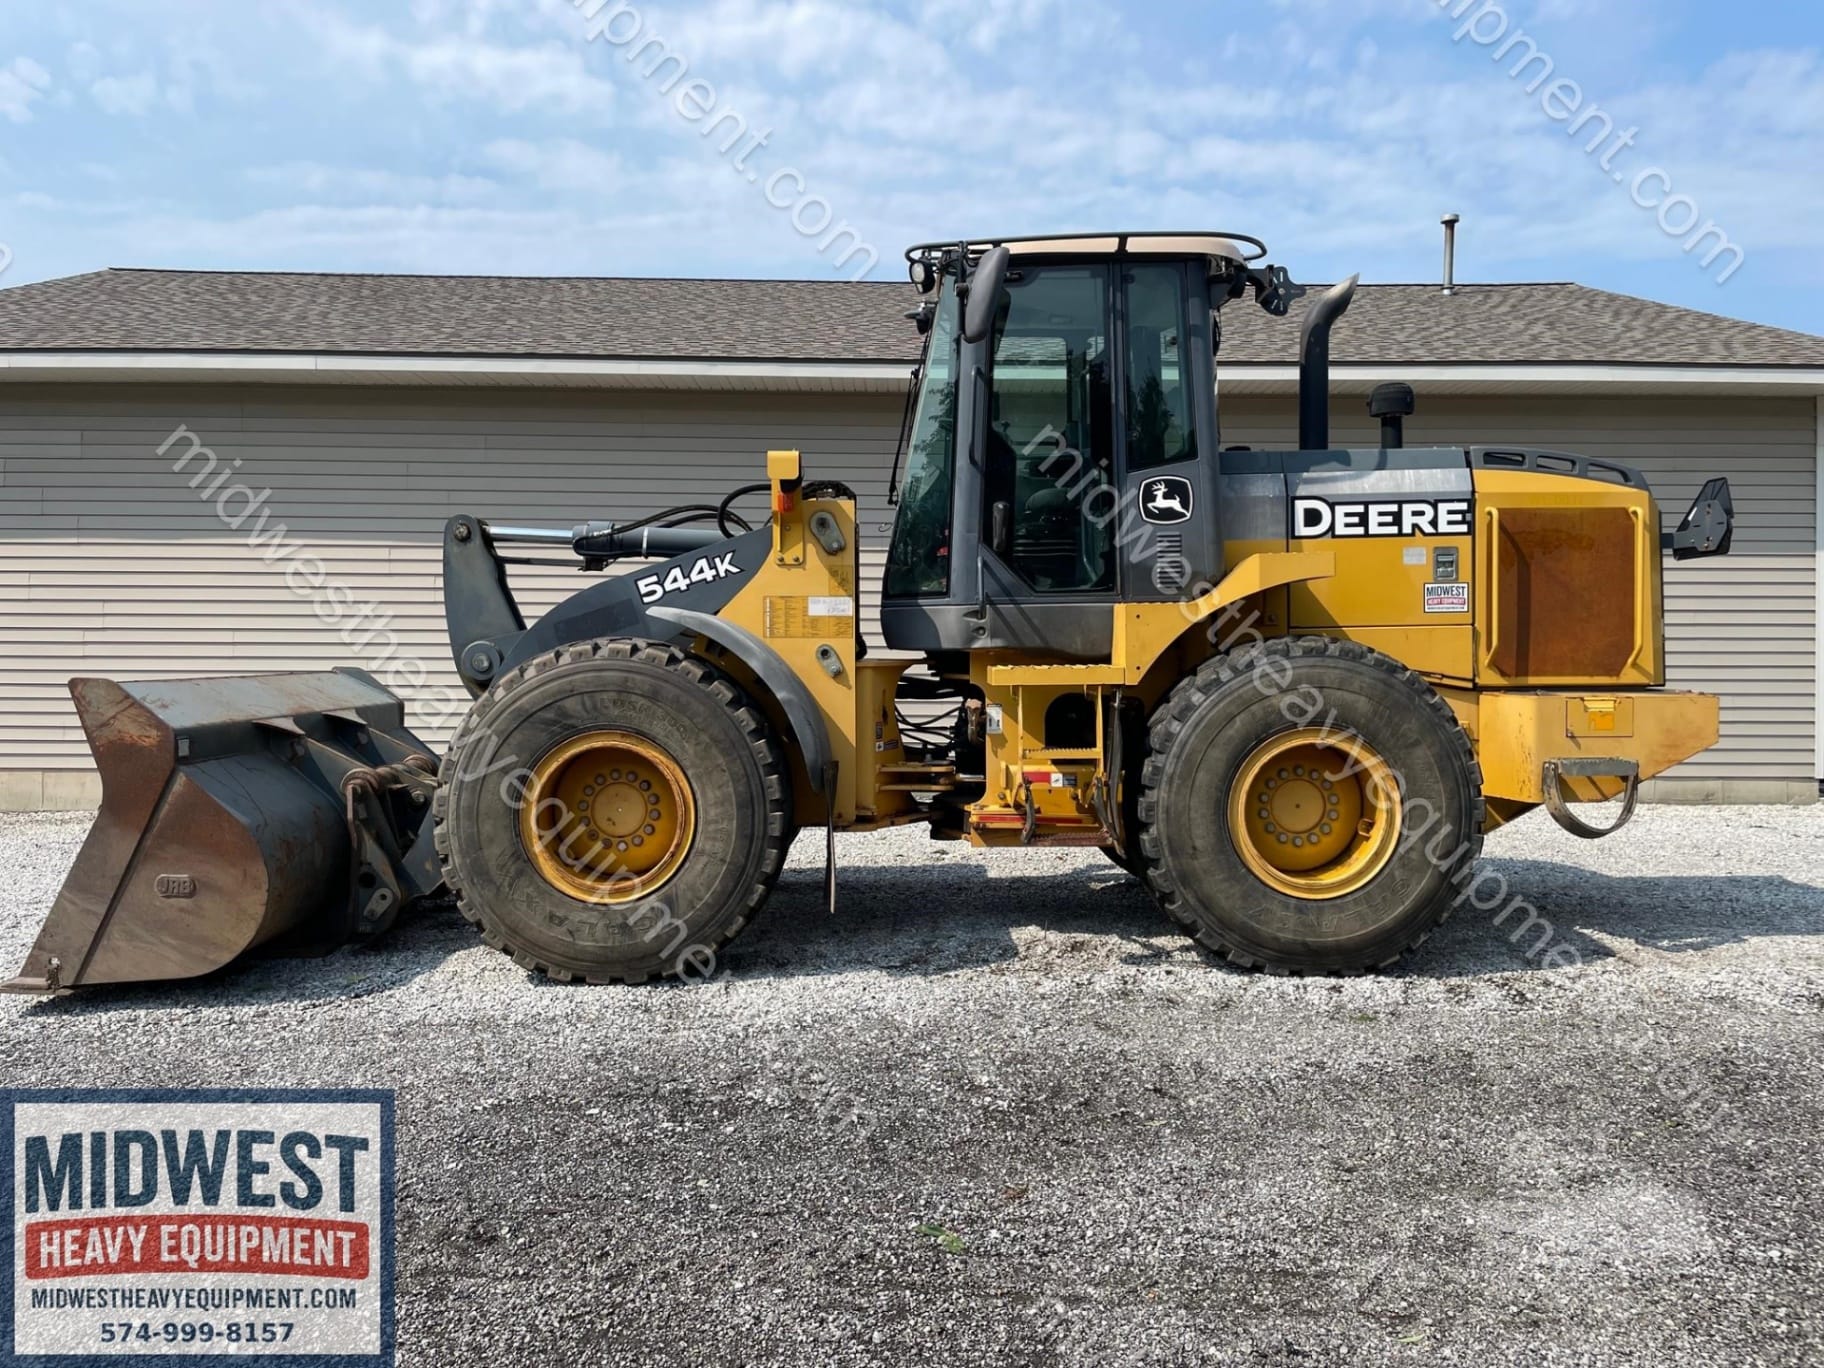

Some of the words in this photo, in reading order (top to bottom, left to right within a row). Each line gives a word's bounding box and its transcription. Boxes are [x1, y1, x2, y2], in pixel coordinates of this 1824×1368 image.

[1294, 499, 1468, 537] DEERE
[636, 551, 742, 604] 544K
[1426, 586, 1466, 598] MIDWEST
